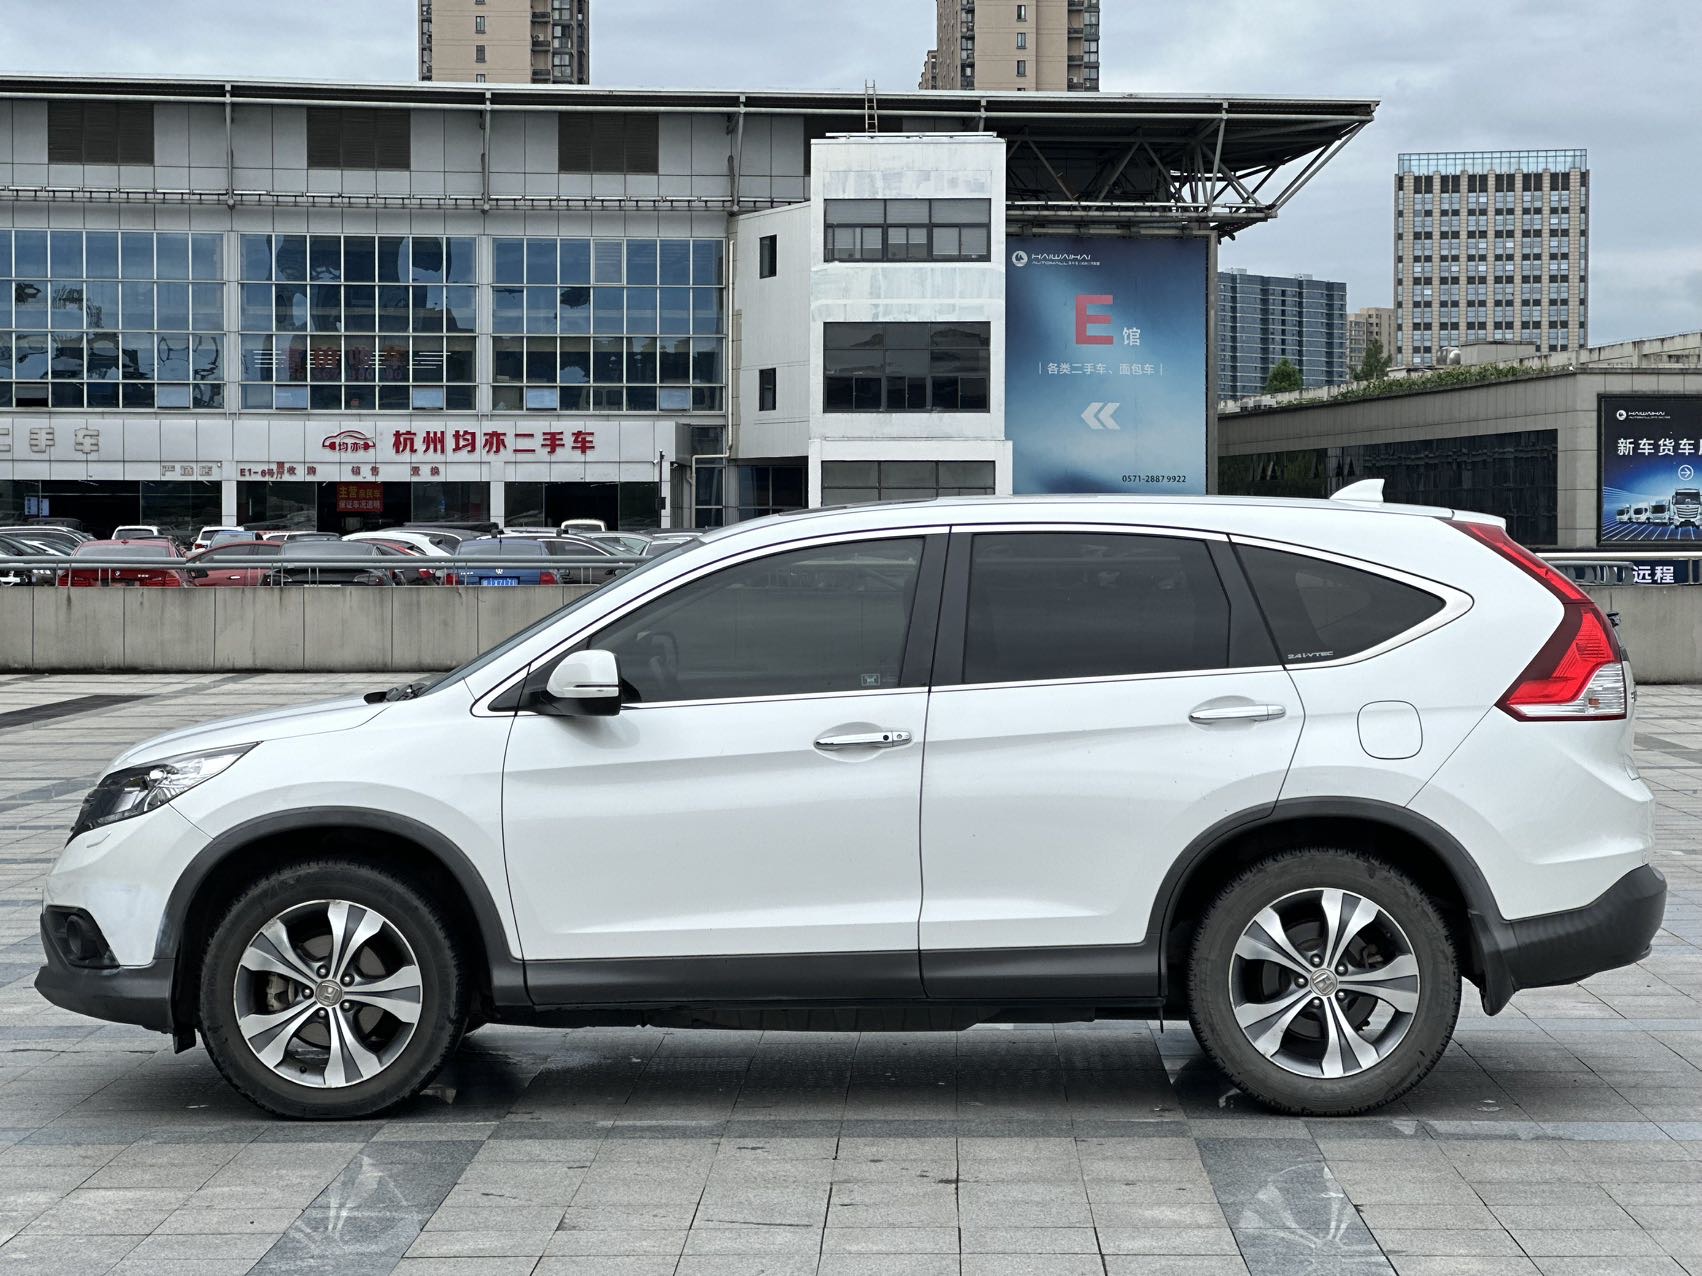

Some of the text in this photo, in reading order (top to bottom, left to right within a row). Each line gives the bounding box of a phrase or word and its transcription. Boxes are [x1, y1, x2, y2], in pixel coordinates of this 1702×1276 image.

[1075, 294, 1141, 346] E 馆
[392, 430, 596, 454] 杭州均亦二手车
[1617, 438, 1702, 456] 新车货车
[1121, 475, 1187, 483] 0571-2887 9922
[1633, 565, 1675, 583] 远程
